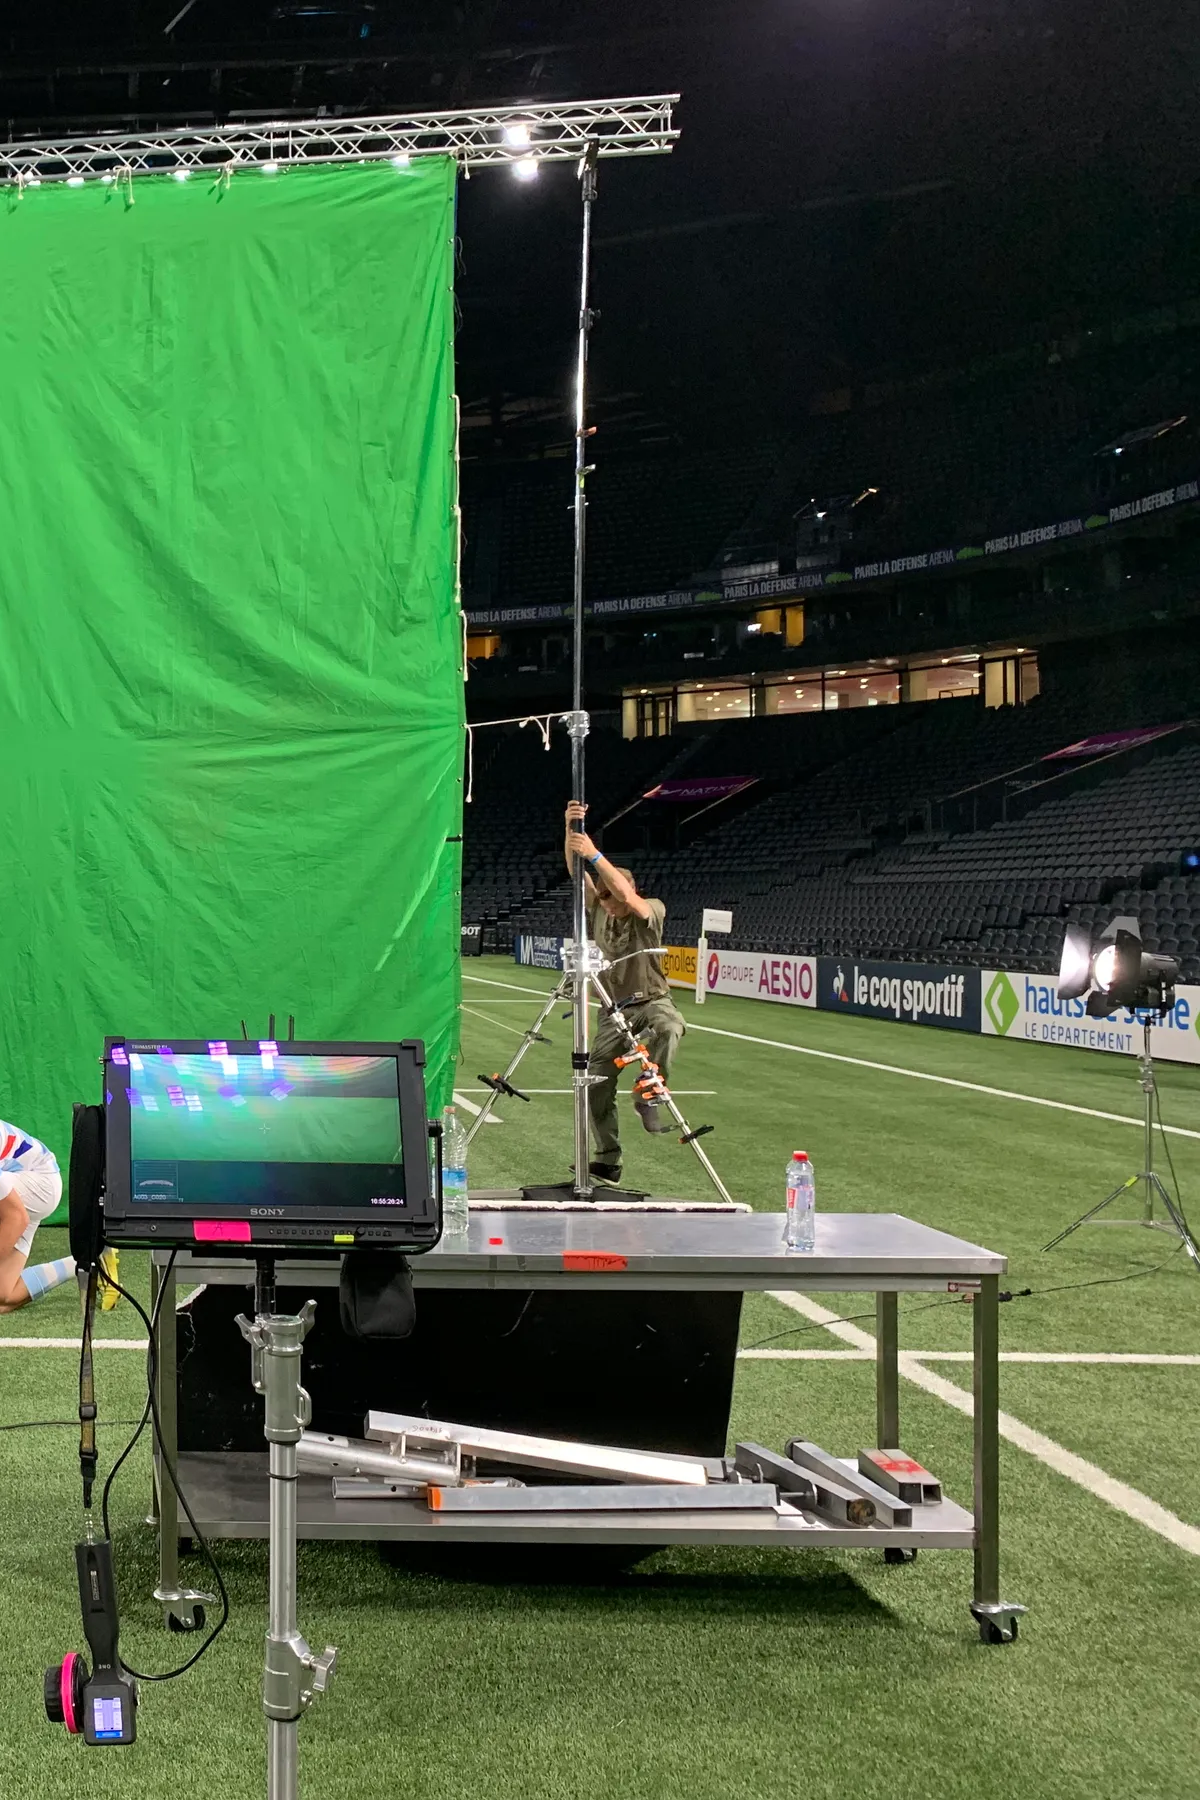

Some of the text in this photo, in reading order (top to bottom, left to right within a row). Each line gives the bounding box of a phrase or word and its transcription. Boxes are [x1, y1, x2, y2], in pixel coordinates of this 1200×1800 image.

[985, 518, 1083, 554] PARIS LA DEFENSE ARENA
[854, 550, 954, 580] PARIS LA DEFENSE ARENA
[724, 574, 823, 599] PARIS LA DEFENSE ARENA
[466, 606, 562, 624] PARIS LA DEFENSE ARENA
[594, 592, 692, 614] PARIS LA DEFENSE ARENA
[460, 926, 480, 936] SOT
[661, 948, 696, 976] ignolles
[720, 964, 754, 984] GROUPE
[758, 959, 813, 1000] AESIO
[854, 966, 964, 1021] le coq sportif
[1024, 1021, 1132, 1052] LE DÉPARTEMENT
[250, 1208, 286, 1216] SONY
